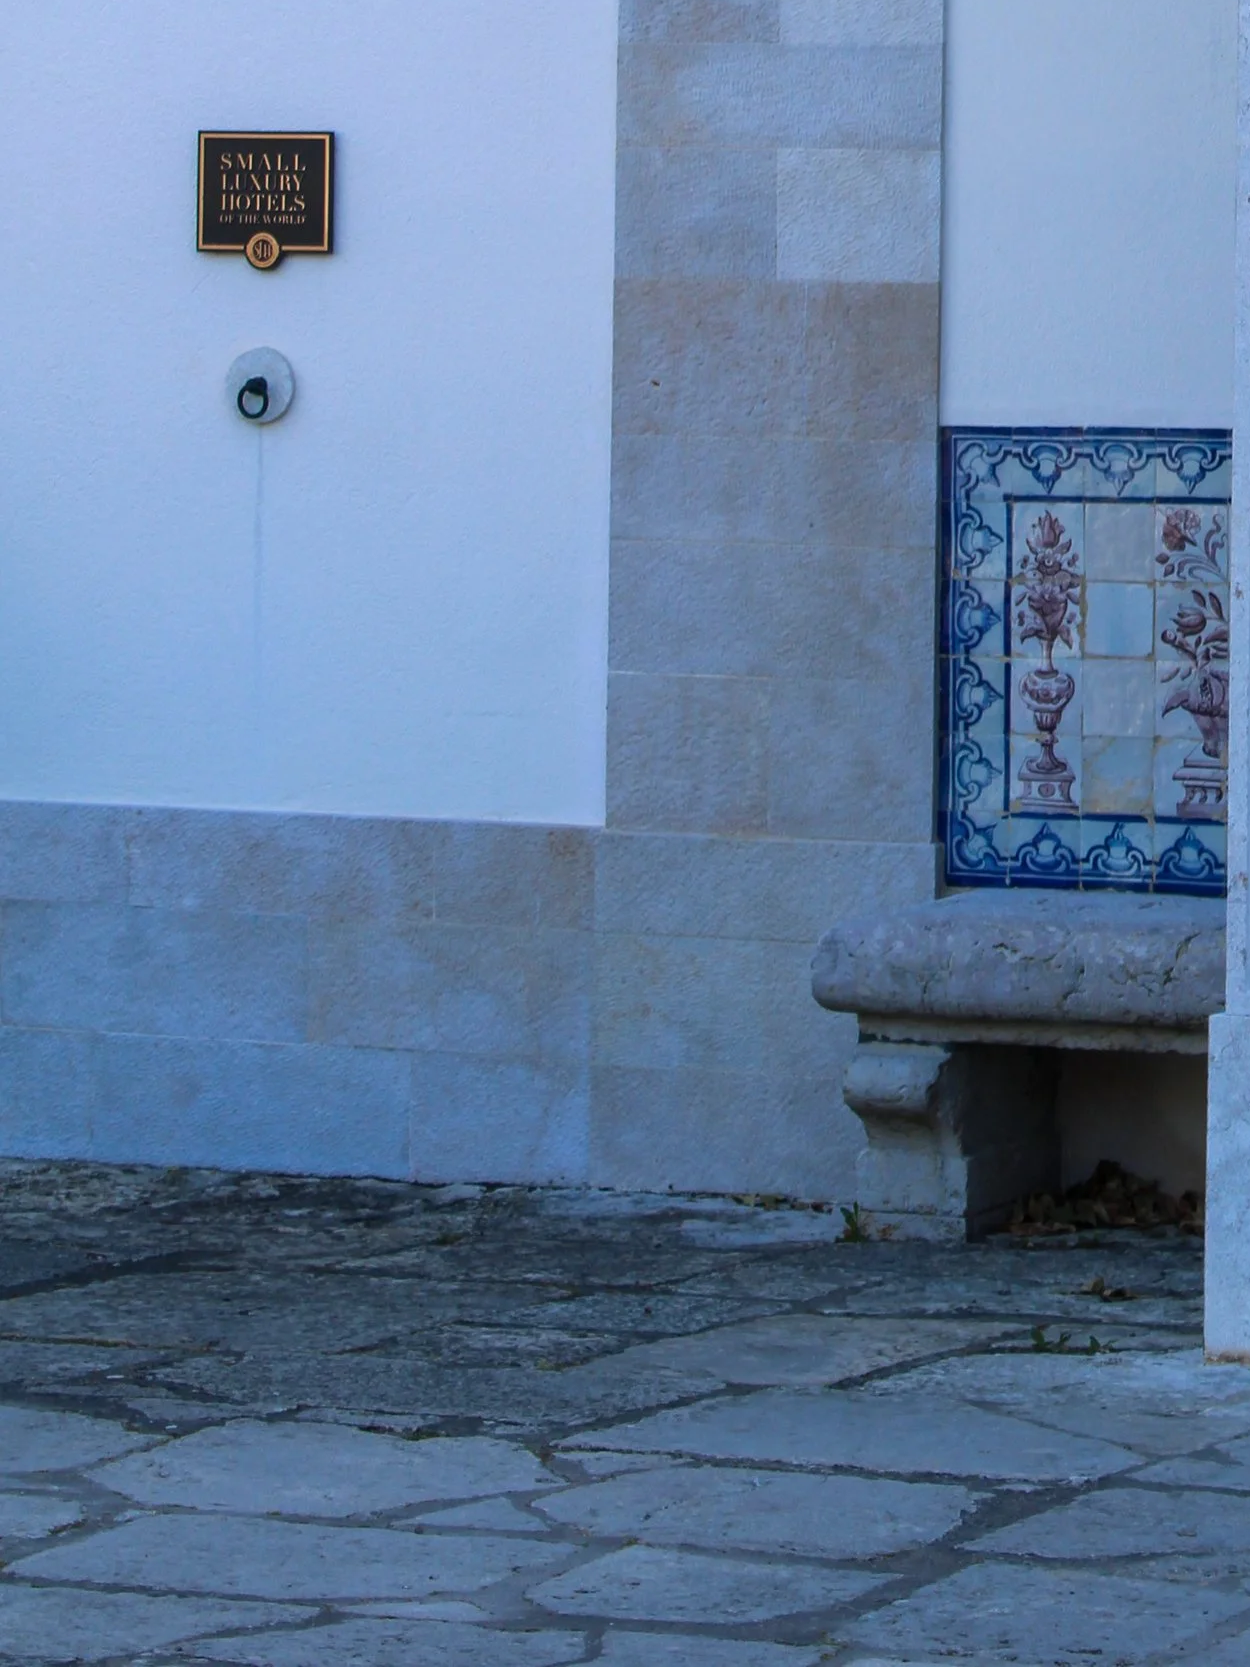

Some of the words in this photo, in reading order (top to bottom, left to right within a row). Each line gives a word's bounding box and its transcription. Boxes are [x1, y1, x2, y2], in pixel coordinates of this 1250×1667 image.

[220, 153, 306, 171] SMALL
[221, 173, 305, 192] LUXURY
[220, 193, 305, 212] HOTELS
[219, 214, 234, 224] OF
[238, 214, 260, 224] THE
[263, 214, 305, 224] WORLD
